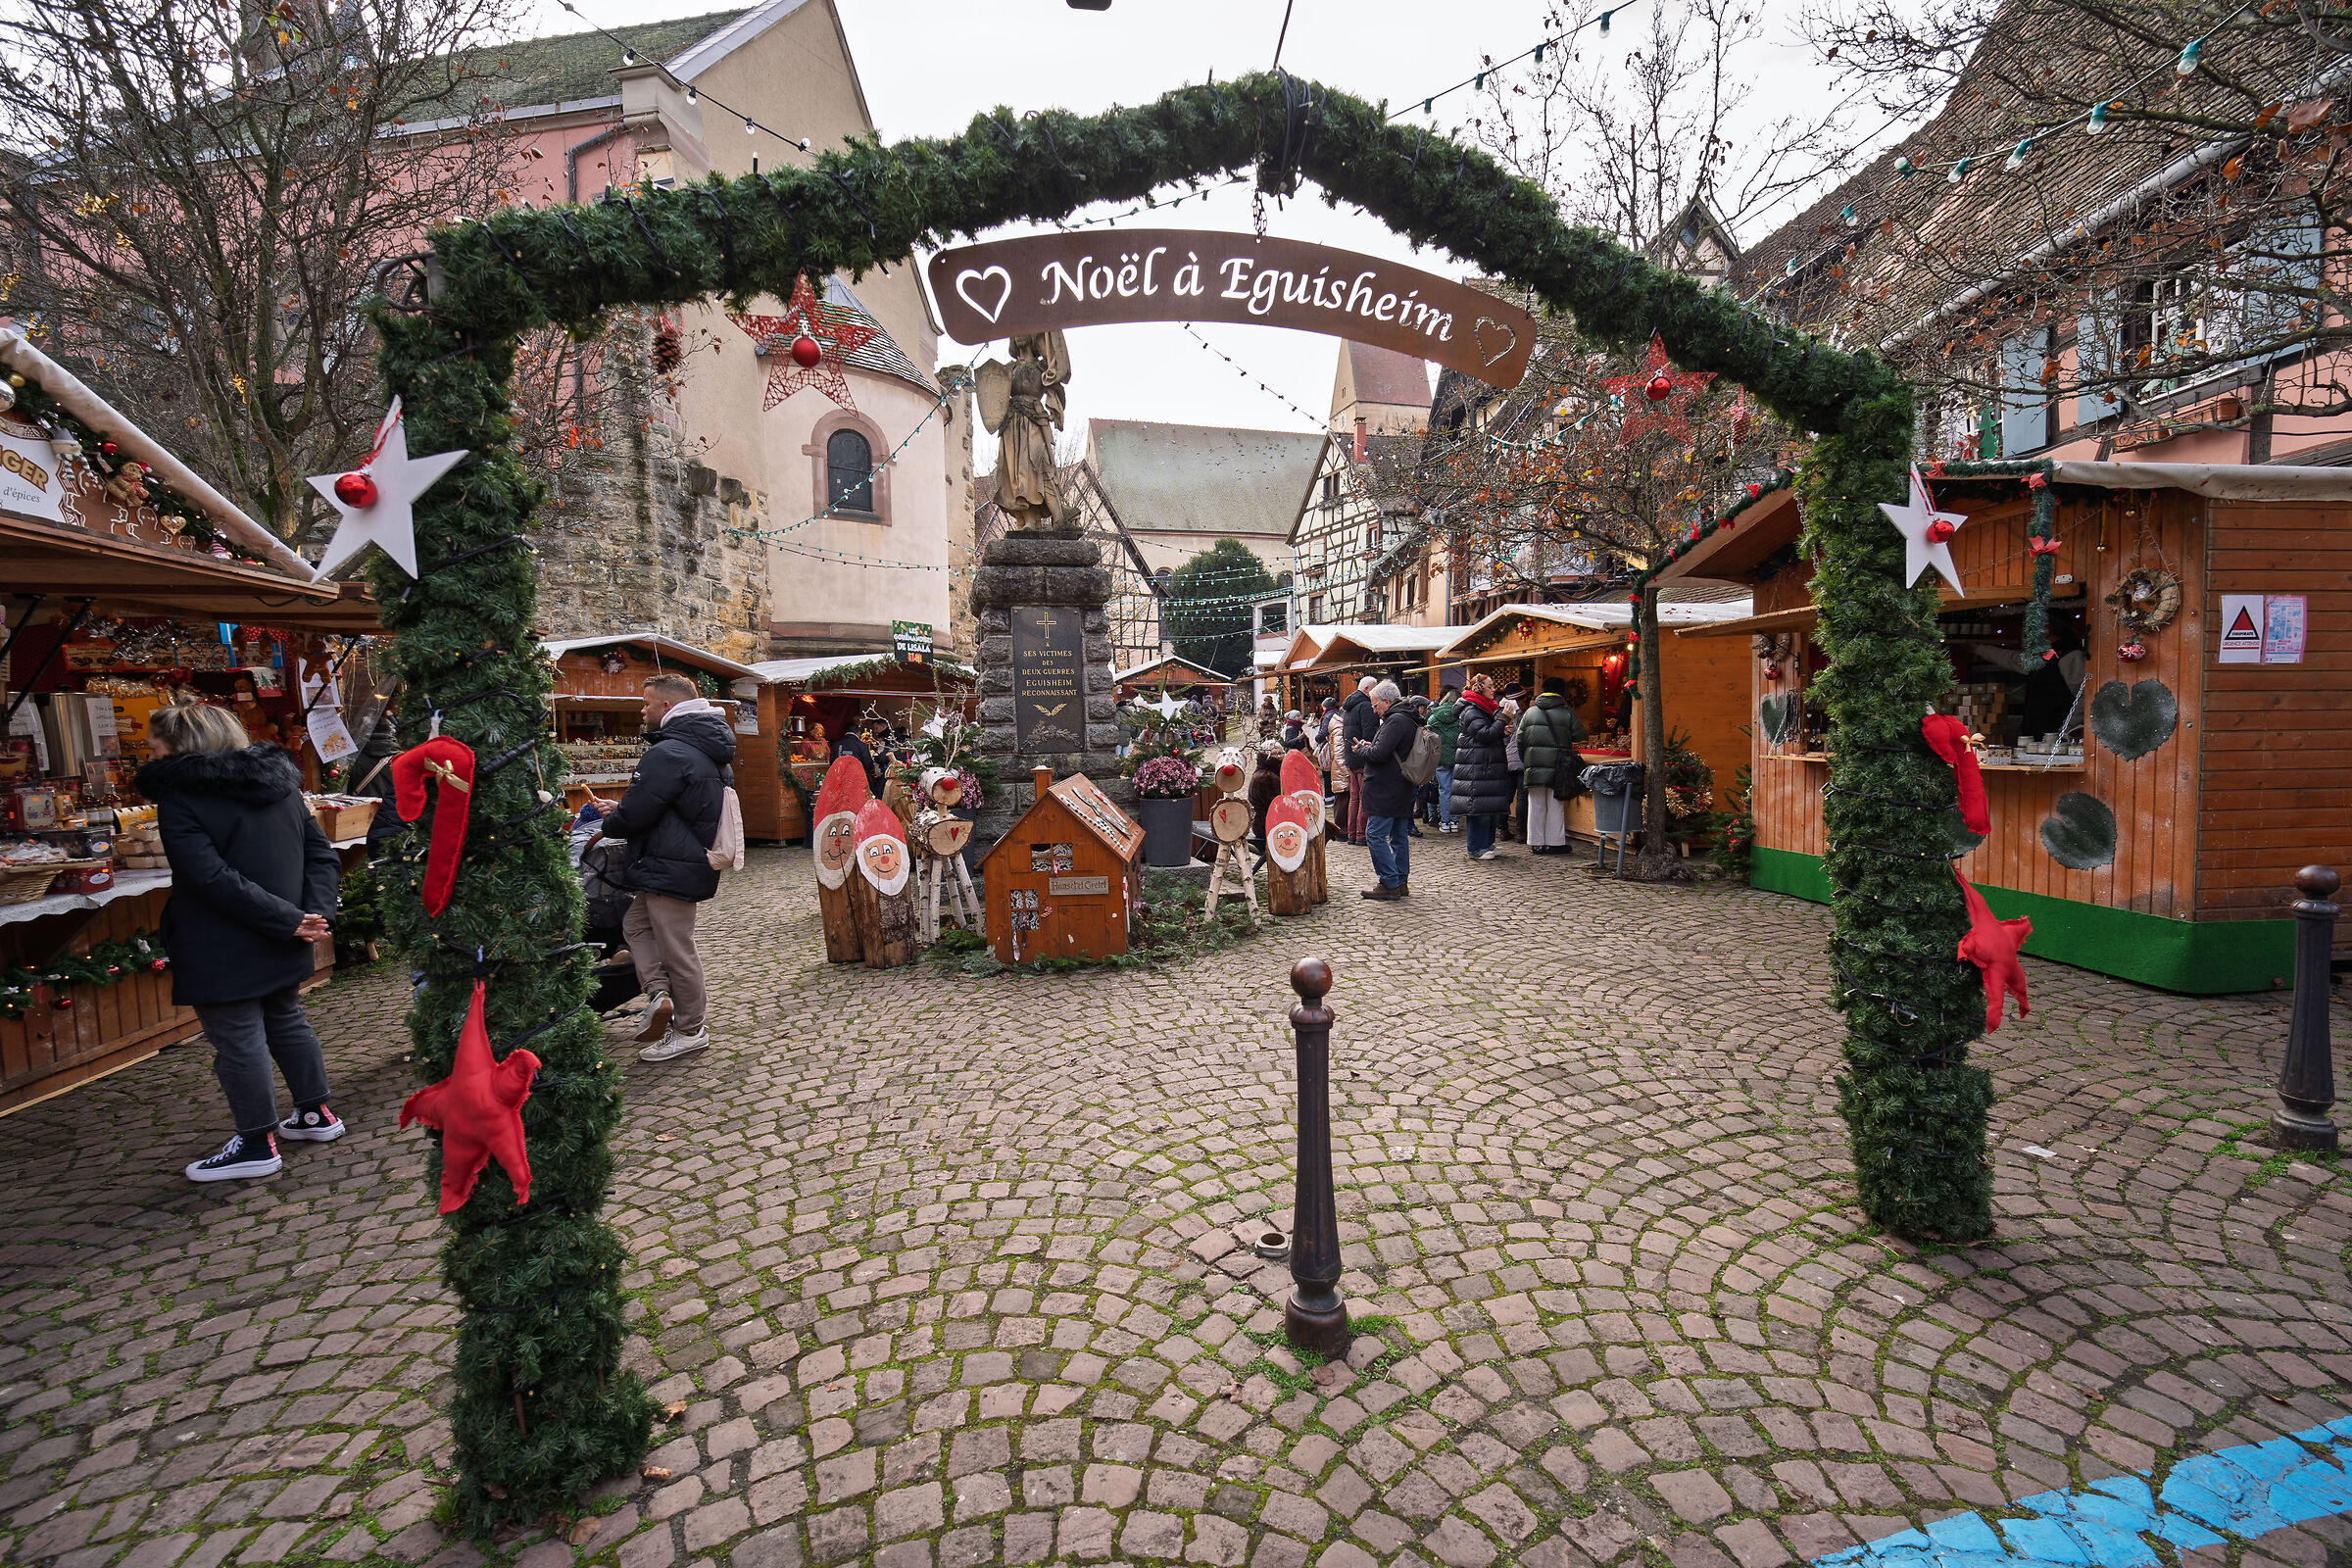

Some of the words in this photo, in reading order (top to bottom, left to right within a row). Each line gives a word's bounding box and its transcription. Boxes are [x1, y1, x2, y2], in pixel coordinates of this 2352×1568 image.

[1040, 246, 1167, 305] Noël
[1173, 250, 1205, 297] à
[1219, 258, 1453, 342] Eguisheim
[0, 444, 49, 494] GER
[3, 486, 41, 503] d'épices
[897, 642, 906, 651] DE
[906, 643, 931, 653] LISALA
